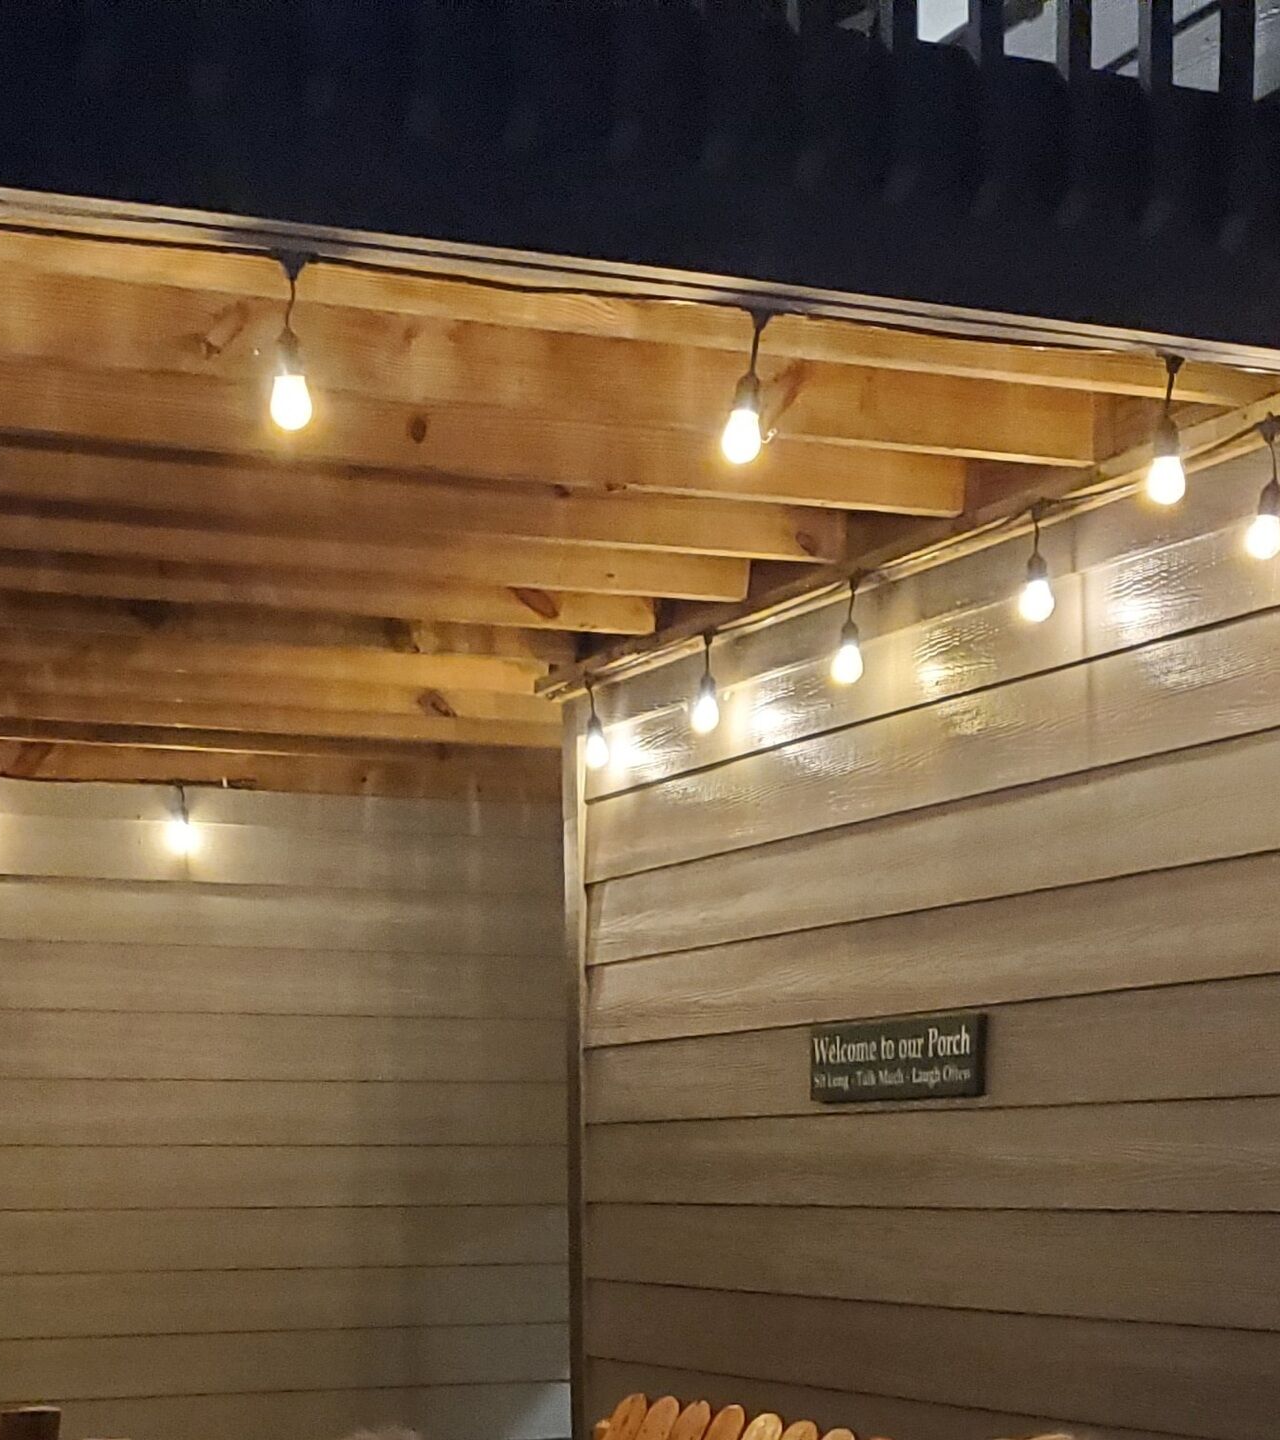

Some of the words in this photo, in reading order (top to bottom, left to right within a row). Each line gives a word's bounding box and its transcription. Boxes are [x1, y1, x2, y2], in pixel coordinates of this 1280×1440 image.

[813, 1035, 877, 1065] Welcome
[881, 1034, 895, 1060] to
[898, 1037, 924, 1059] our
[928, 1024, 971, 1058] Porch
[911, 1066, 941, 1089] Laugh
[943, 1064, 971, 1081] Often
